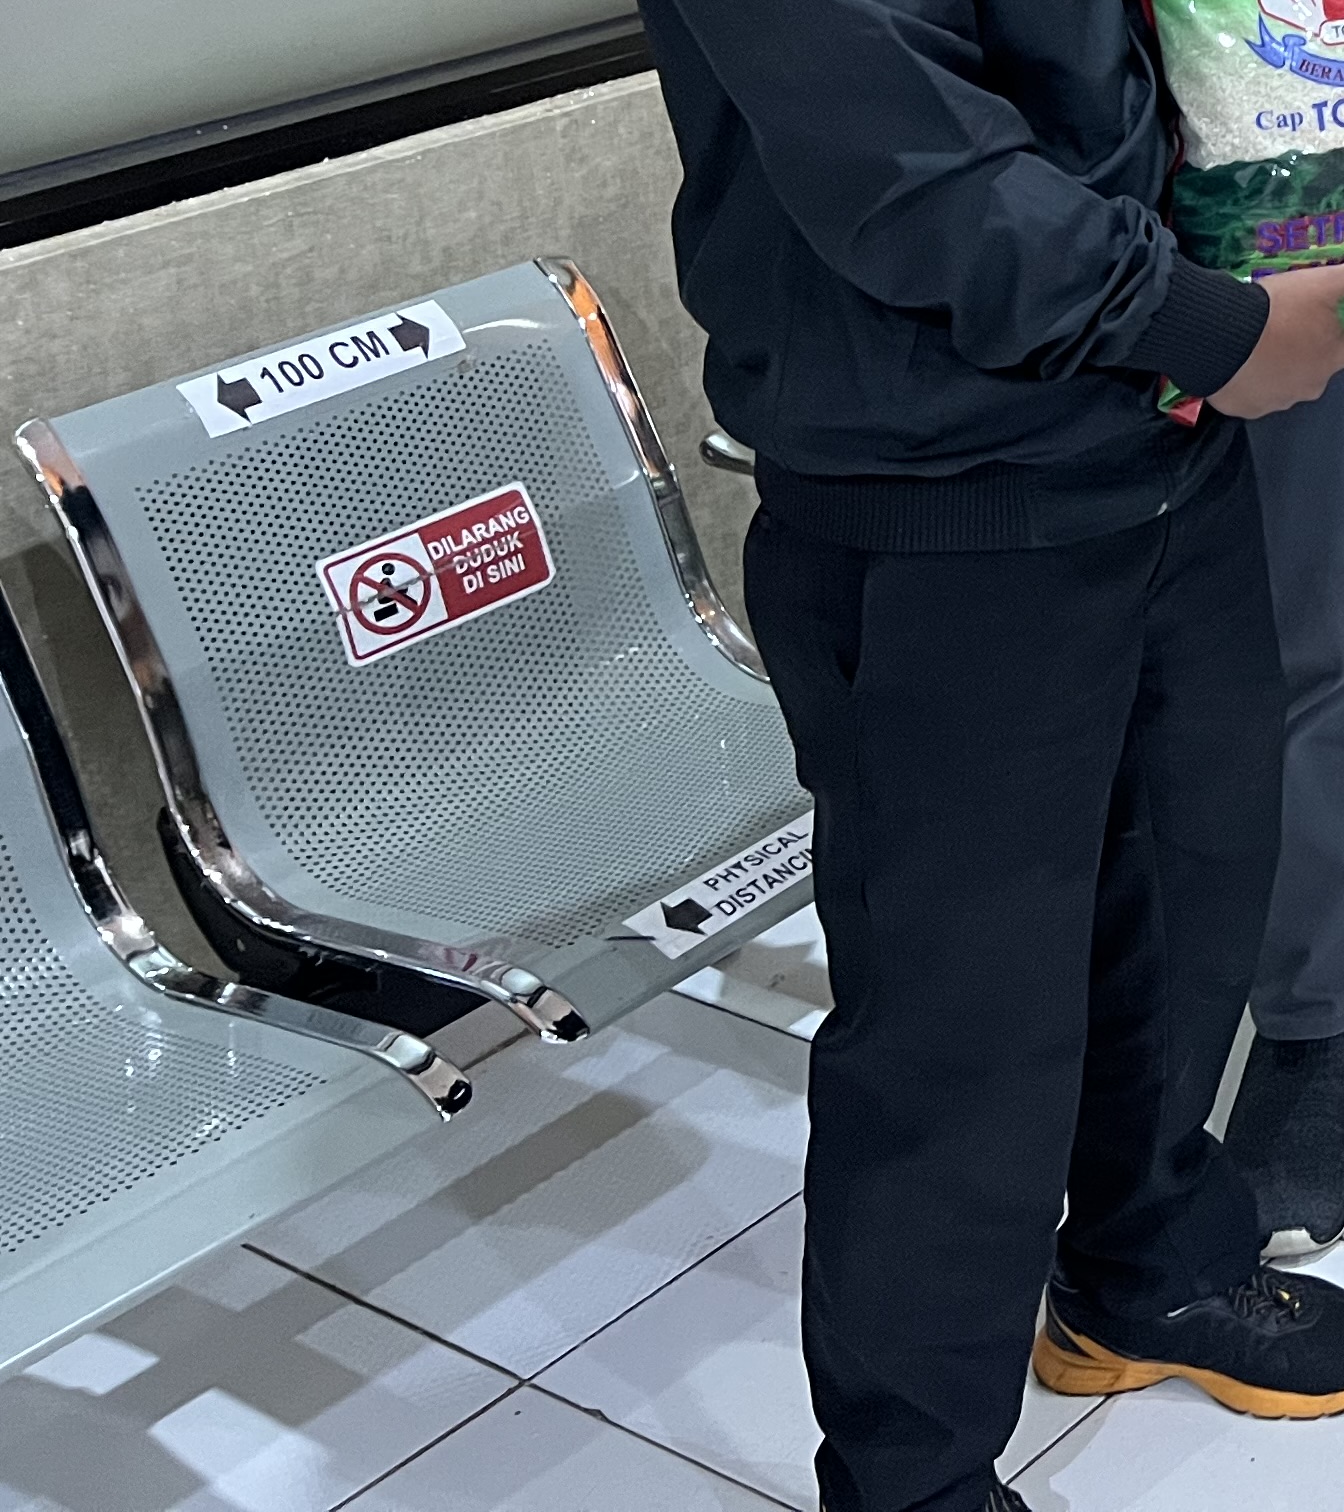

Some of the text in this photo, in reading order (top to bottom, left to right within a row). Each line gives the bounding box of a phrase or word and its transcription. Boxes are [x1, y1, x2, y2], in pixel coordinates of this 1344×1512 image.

[1255, 109, 1304, 133] Cap
[260, 331, 390, 393] 100 CM
[427, 506, 530, 560] DILARANG
[453, 531, 524, 575] DUDUK
[462, 553, 526, 594] DI SINI
[703, 831, 809, 892] PHYSICAL
